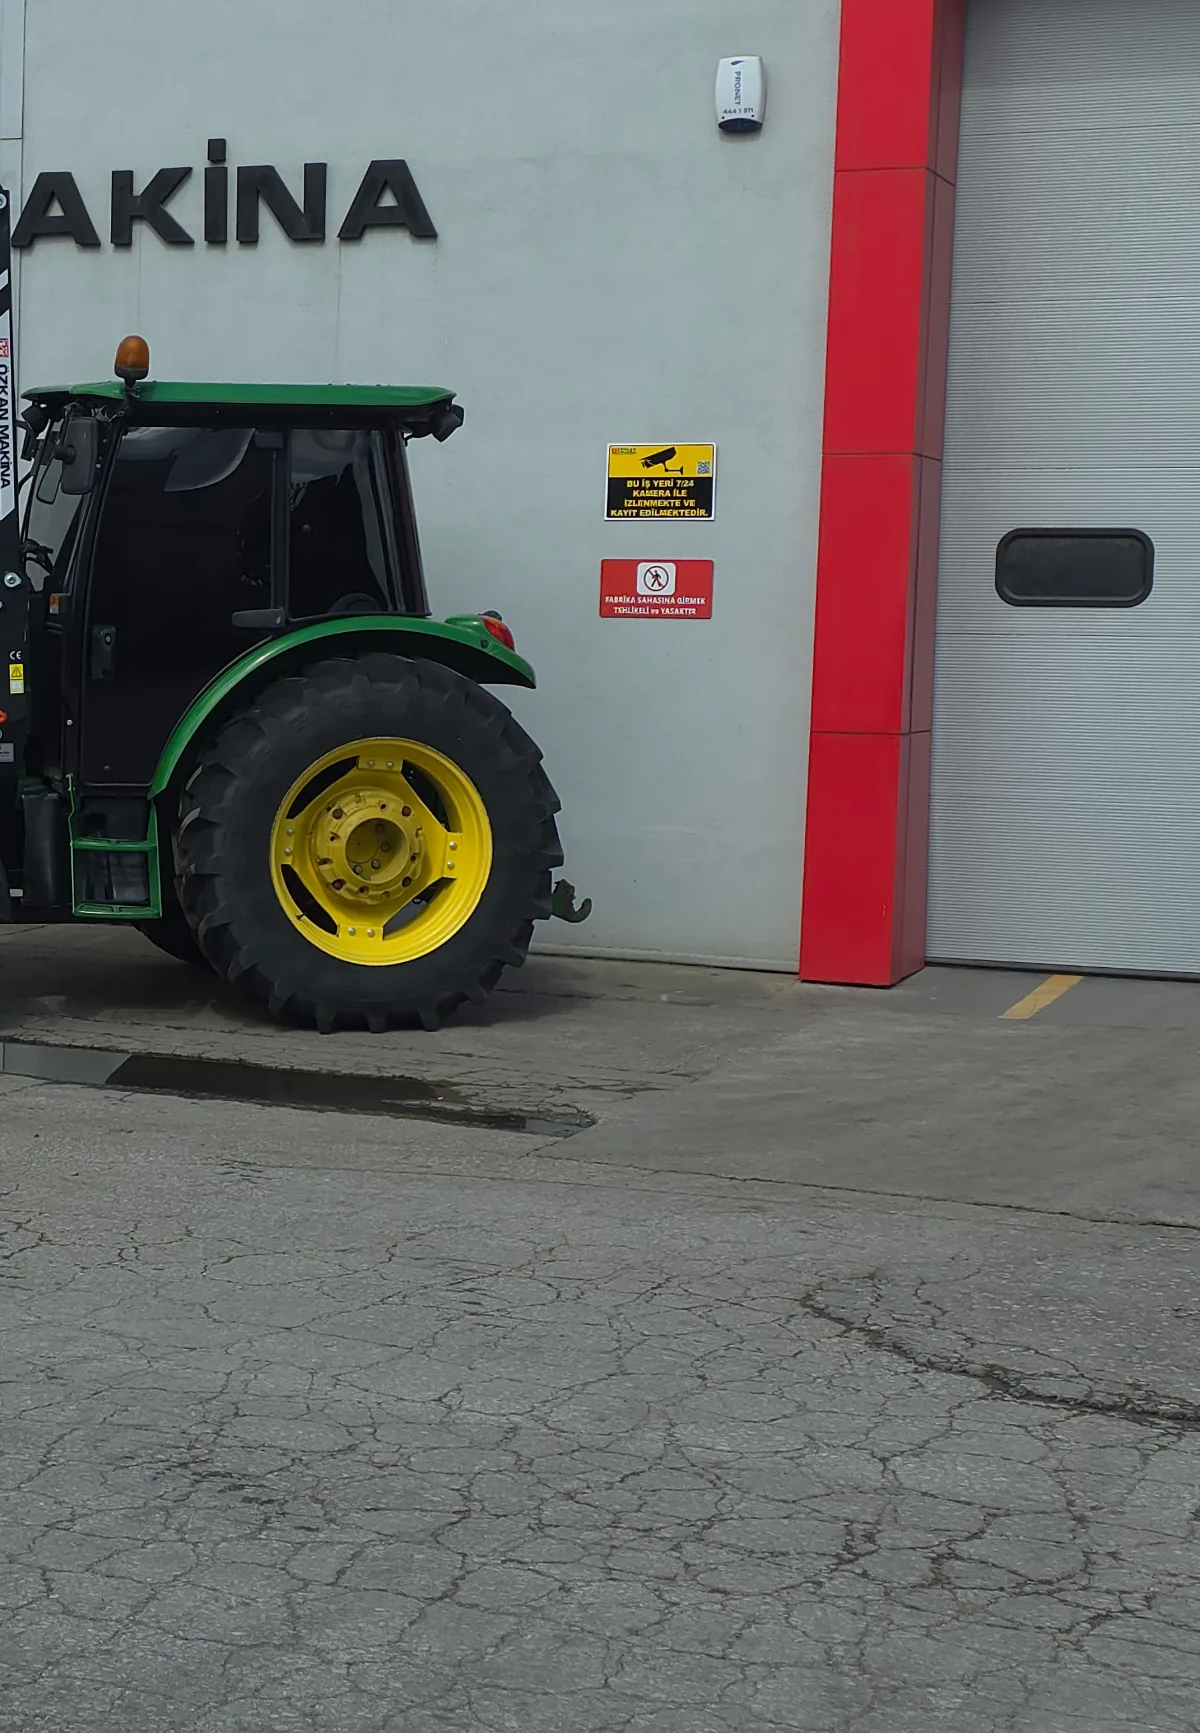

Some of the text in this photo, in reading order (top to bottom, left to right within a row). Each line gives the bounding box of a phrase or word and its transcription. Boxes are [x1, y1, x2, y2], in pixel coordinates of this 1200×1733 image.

[11, 138, 438, 248] AKİNA
[641, 479, 650, 489] İŞ
[653, 479, 673, 487] YERİ
[673, 489, 688, 497] İLE
[624, 498, 681, 507] İZLENMEKTE
[610, 509, 637, 517] KAYIT
[605, 595, 636, 604] FABRİKA
[637, 597, 676, 605] SAHASINA
